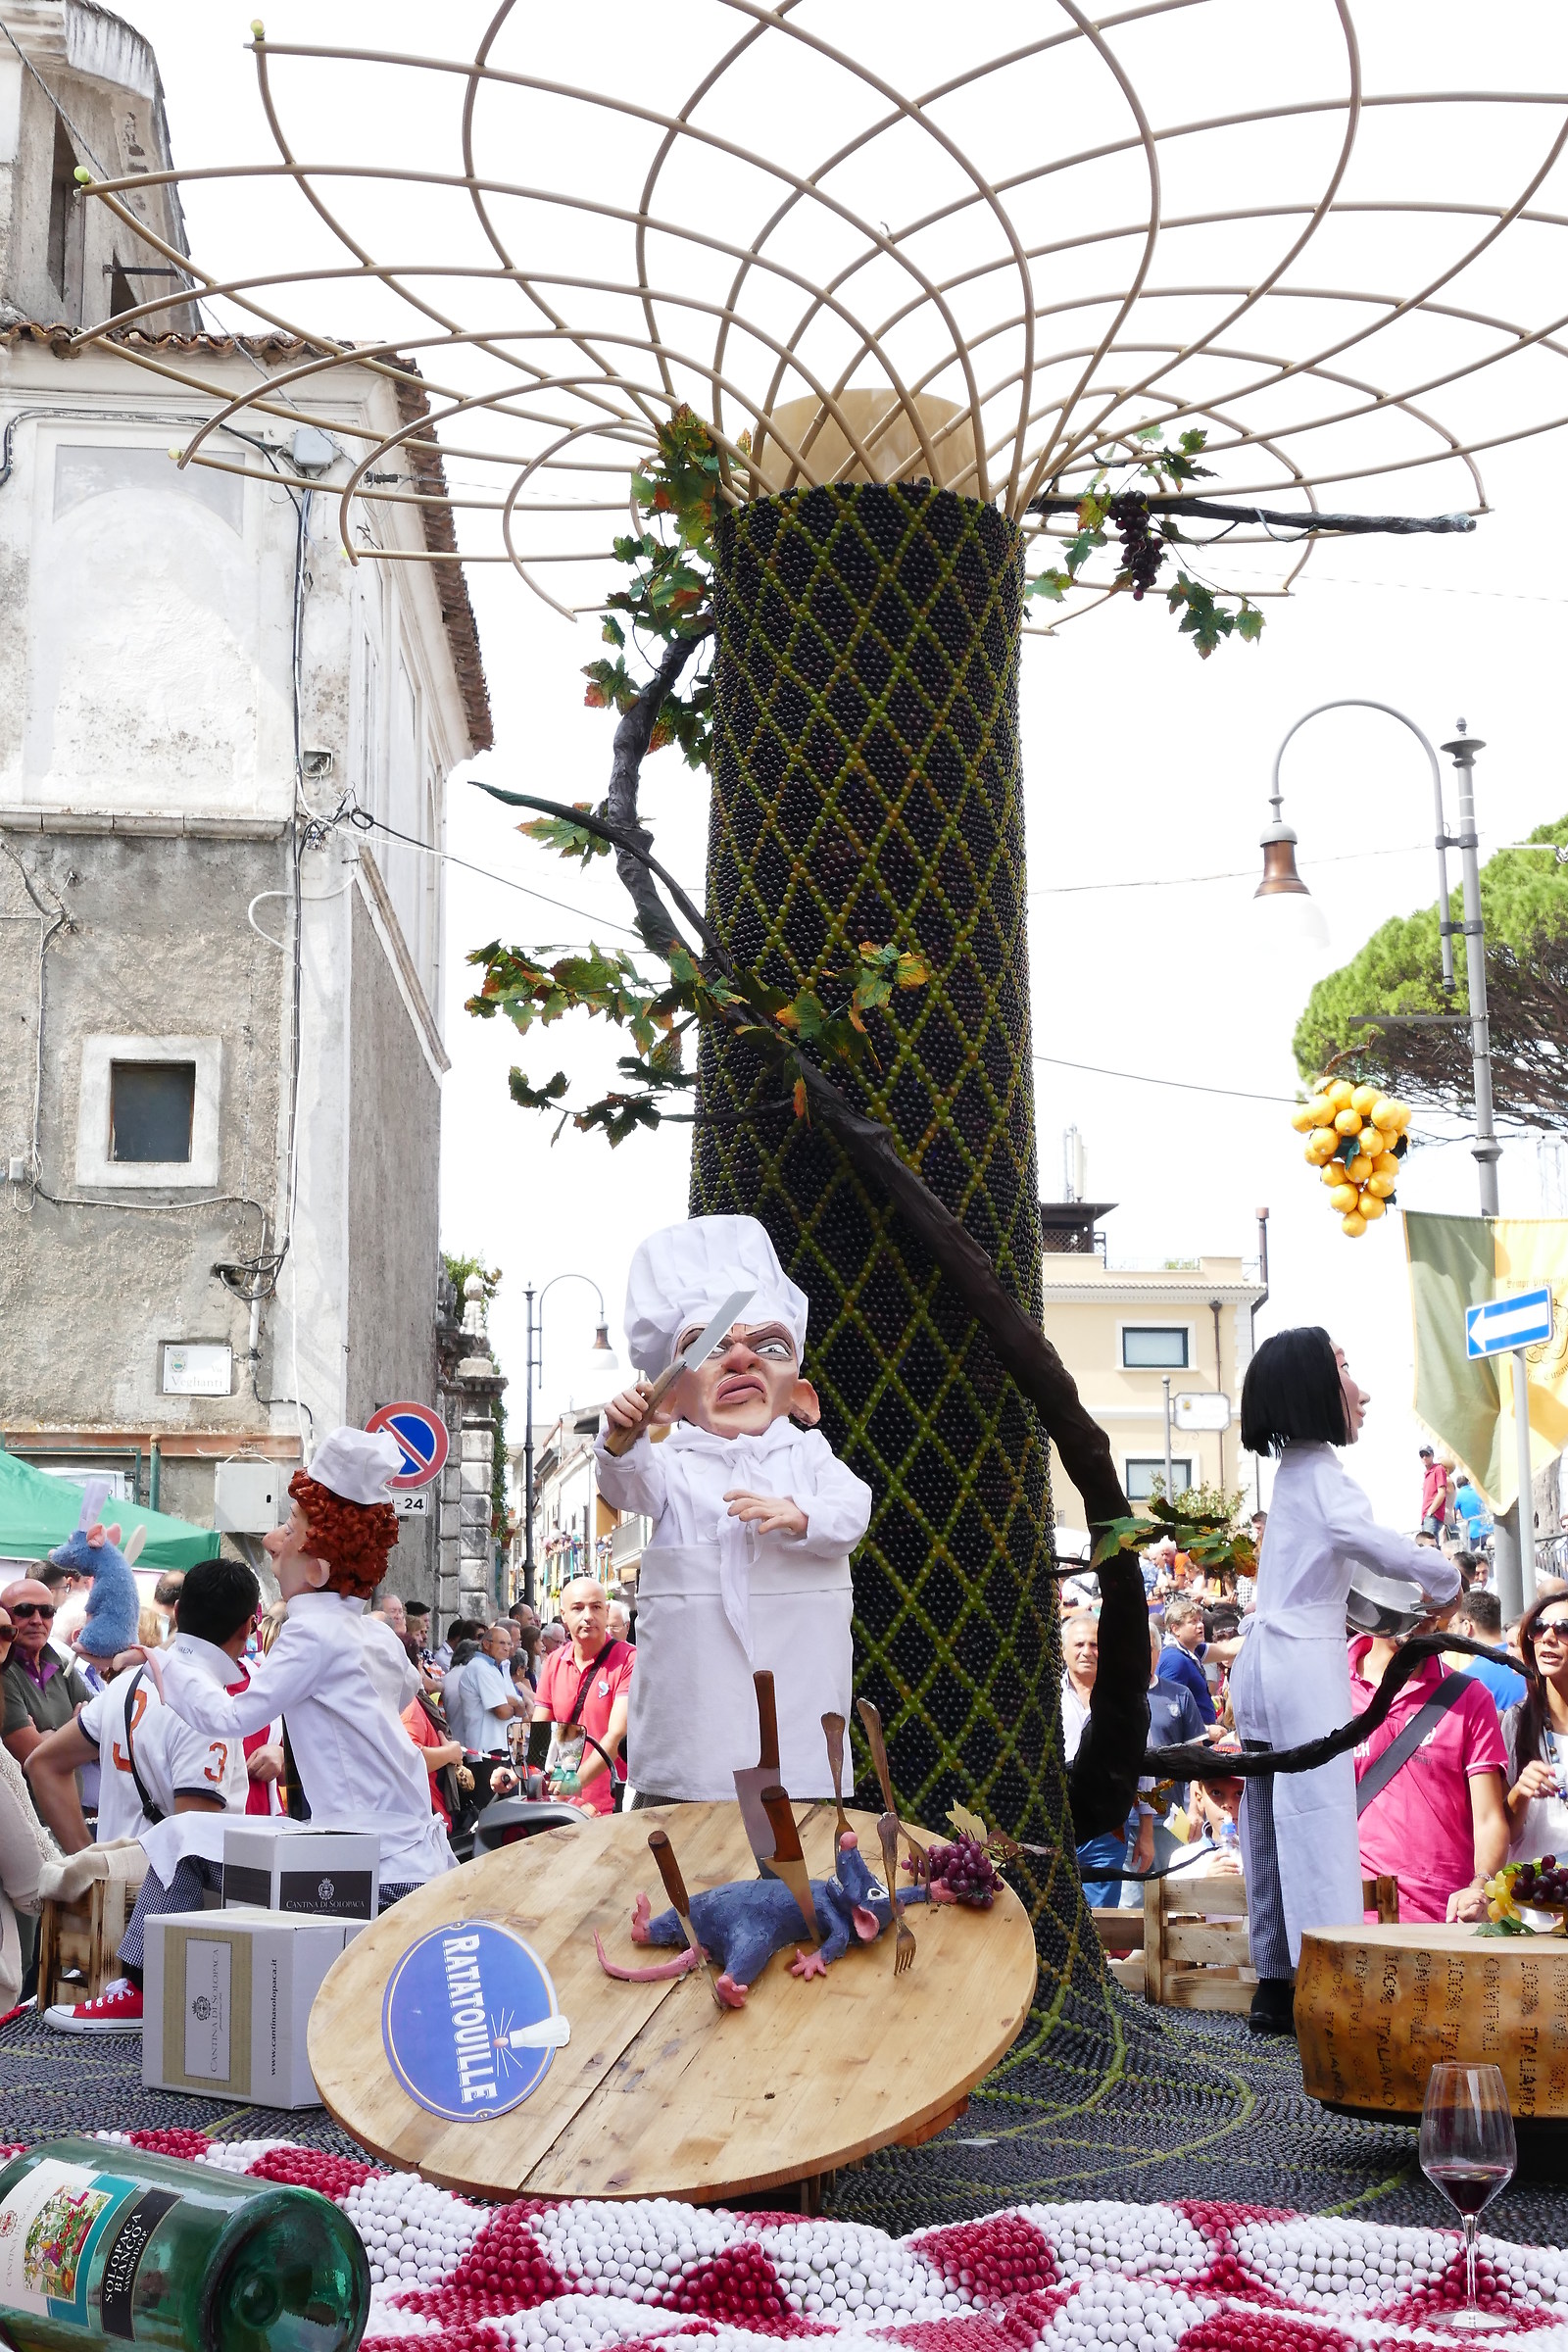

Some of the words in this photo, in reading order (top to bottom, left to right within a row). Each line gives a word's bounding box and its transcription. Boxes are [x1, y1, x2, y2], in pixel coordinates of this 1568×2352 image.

[172, 1375, 222, 1389] Veglianti
[204, 1741, 227, 1784] 3
[285, 1900, 318, 1909] CANTINA
[328, 1899, 365, 1908] SOLOPACA
[1349, 1949, 1369, 2039] ITALIANO
[1380, 1954, 1399, 2005] 100%
[1410, 1951, 1432, 2046] ITALIANO
[1446, 1958, 1465, 2011] 100%
[1482, 1957, 1500, 2051] ITALIANO
[1521, 1961, 1540, 2017] 100%
[212, 2006, 219, 2019] DI
[270, 1959, 278, 2077] www.cantinasolopaca.it
[443, 1935, 498, 2103] RATATOUILLE
[210, 2023, 219, 2073] CANTINA
[1324, 2011, 1345, 2101] ITALIANO
[1376, 2016, 1396, 2106] ITALIANO
[1519, 2026, 1539, 2117] ITALIANO
[104, 2213, 142, 2303] SOLOPACA
[114, 2227, 142, 2292] BIANCO
[123, 2256, 137, 2293] SANNIO
